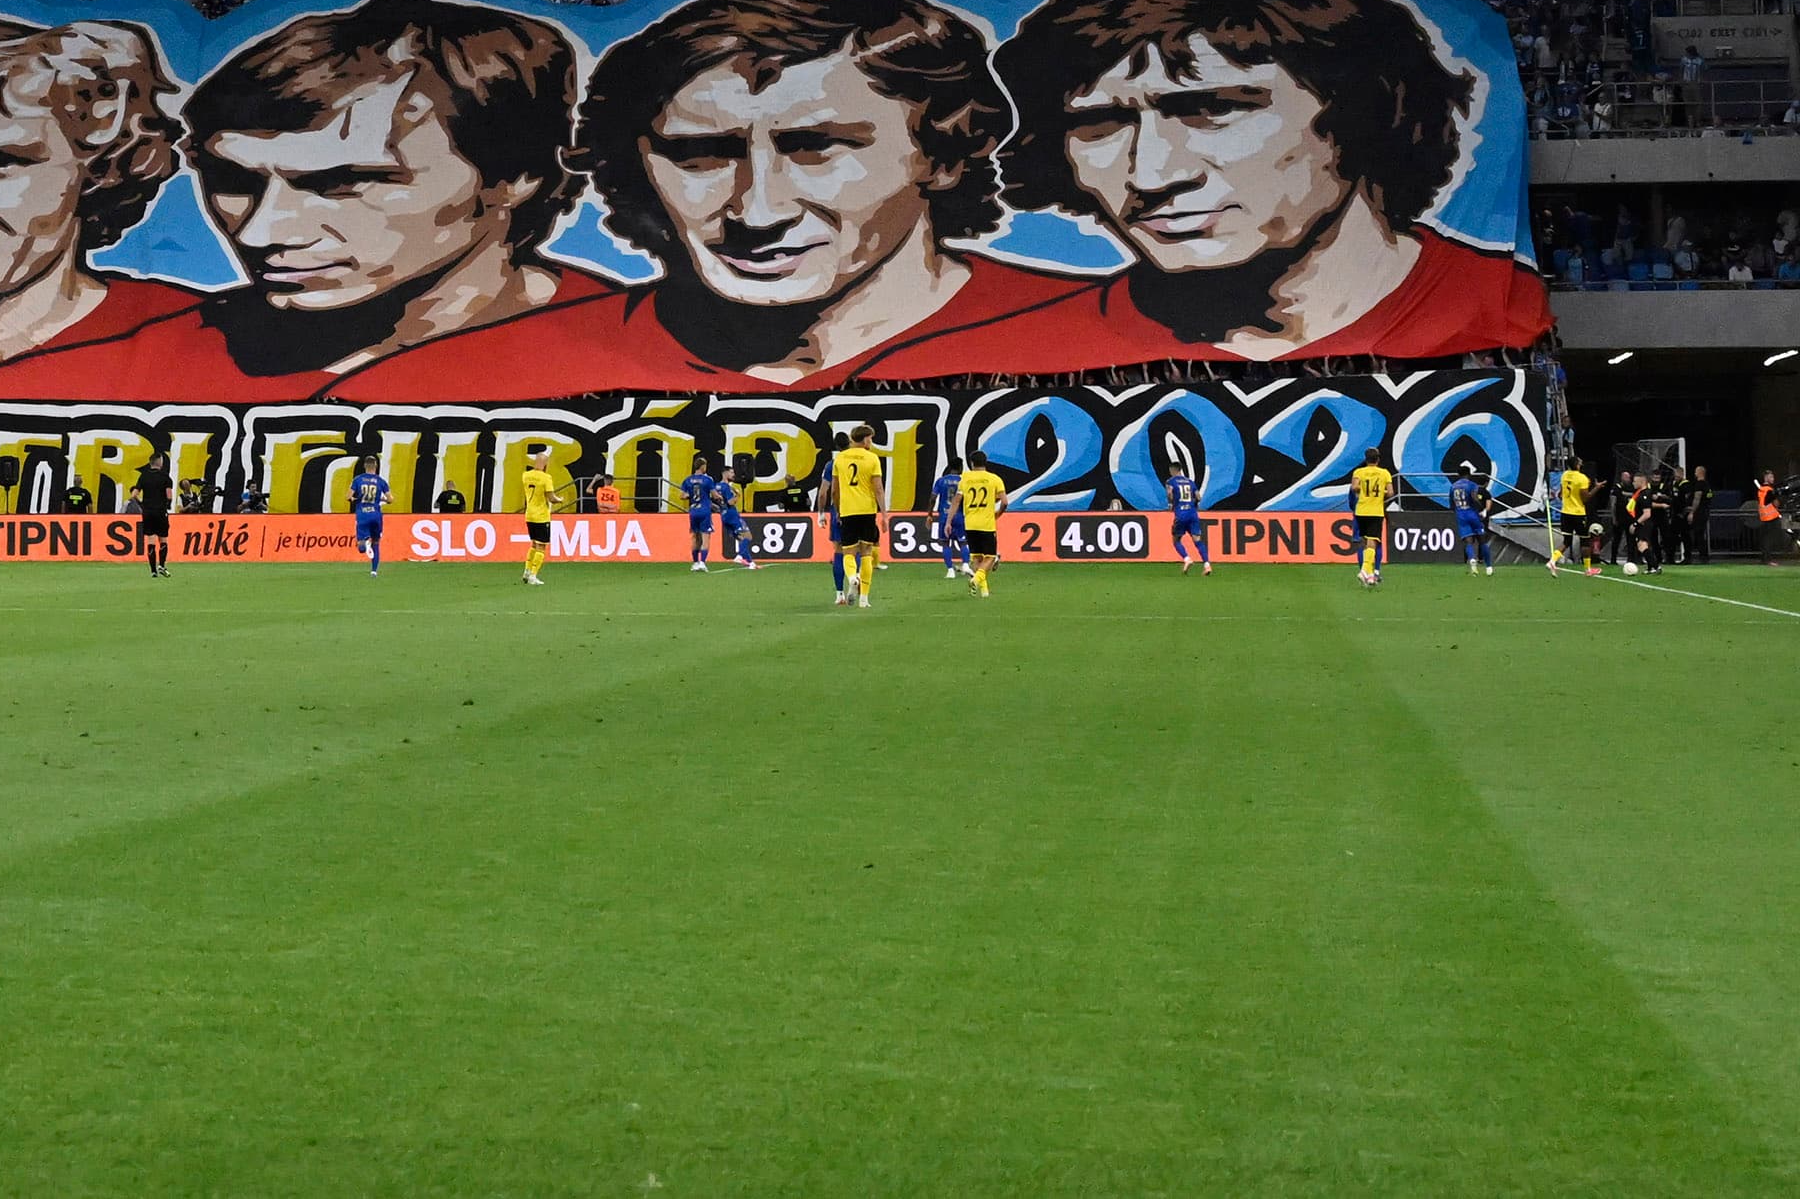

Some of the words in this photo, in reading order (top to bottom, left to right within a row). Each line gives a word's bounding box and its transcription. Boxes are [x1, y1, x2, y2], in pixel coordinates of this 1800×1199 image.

[978, 378, 1518, 512] 2026
[847, 463, 858, 486] 2
[528, 484, 536, 506] 7
[600, 492, 615, 502] 254
[967, 487, 988, 509] 22
[1365, 480, 1380, 498] 14
[106, 520, 145, 556] SI
[183, 519, 249, 556] niké
[275, 531, 291, 553] je
[410, 519, 497, 557] SLO
[549, 520, 650, 557] MJA
[1020, 522, 1042, 552] 2
[1060, 521, 1144, 553] 4.00
[1394, 527, 1455, 552] 07:00
